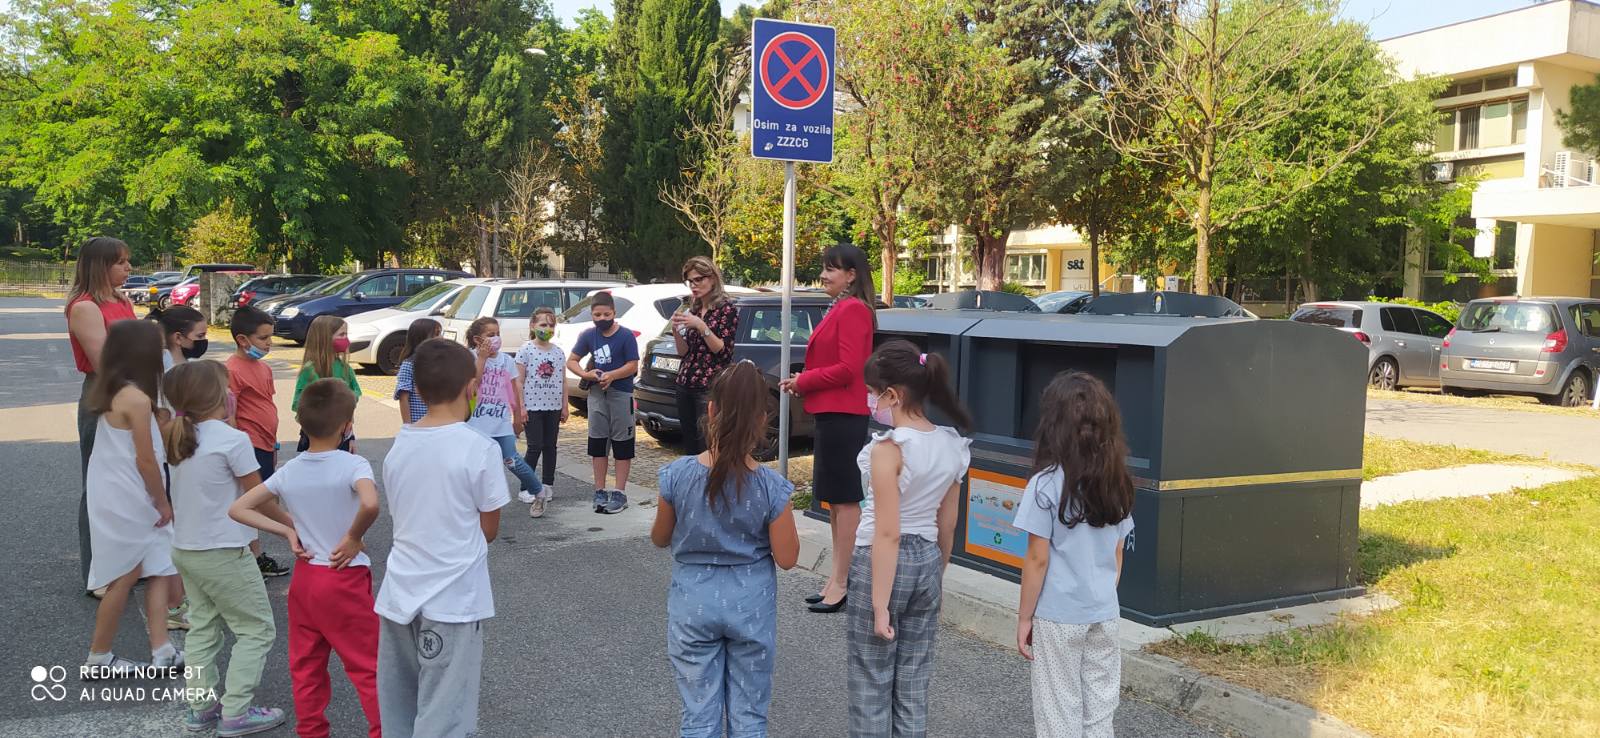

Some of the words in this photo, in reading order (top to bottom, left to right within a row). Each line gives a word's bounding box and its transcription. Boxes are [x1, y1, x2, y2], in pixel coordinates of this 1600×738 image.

[754, 119, 779, 131] Osim
[785, 123, 797, 132] za
[803, 124, 831, 135] vozila
[777, 136, 809, 148] ZZZCG
[1067, 258, 1085, 270] s&t
